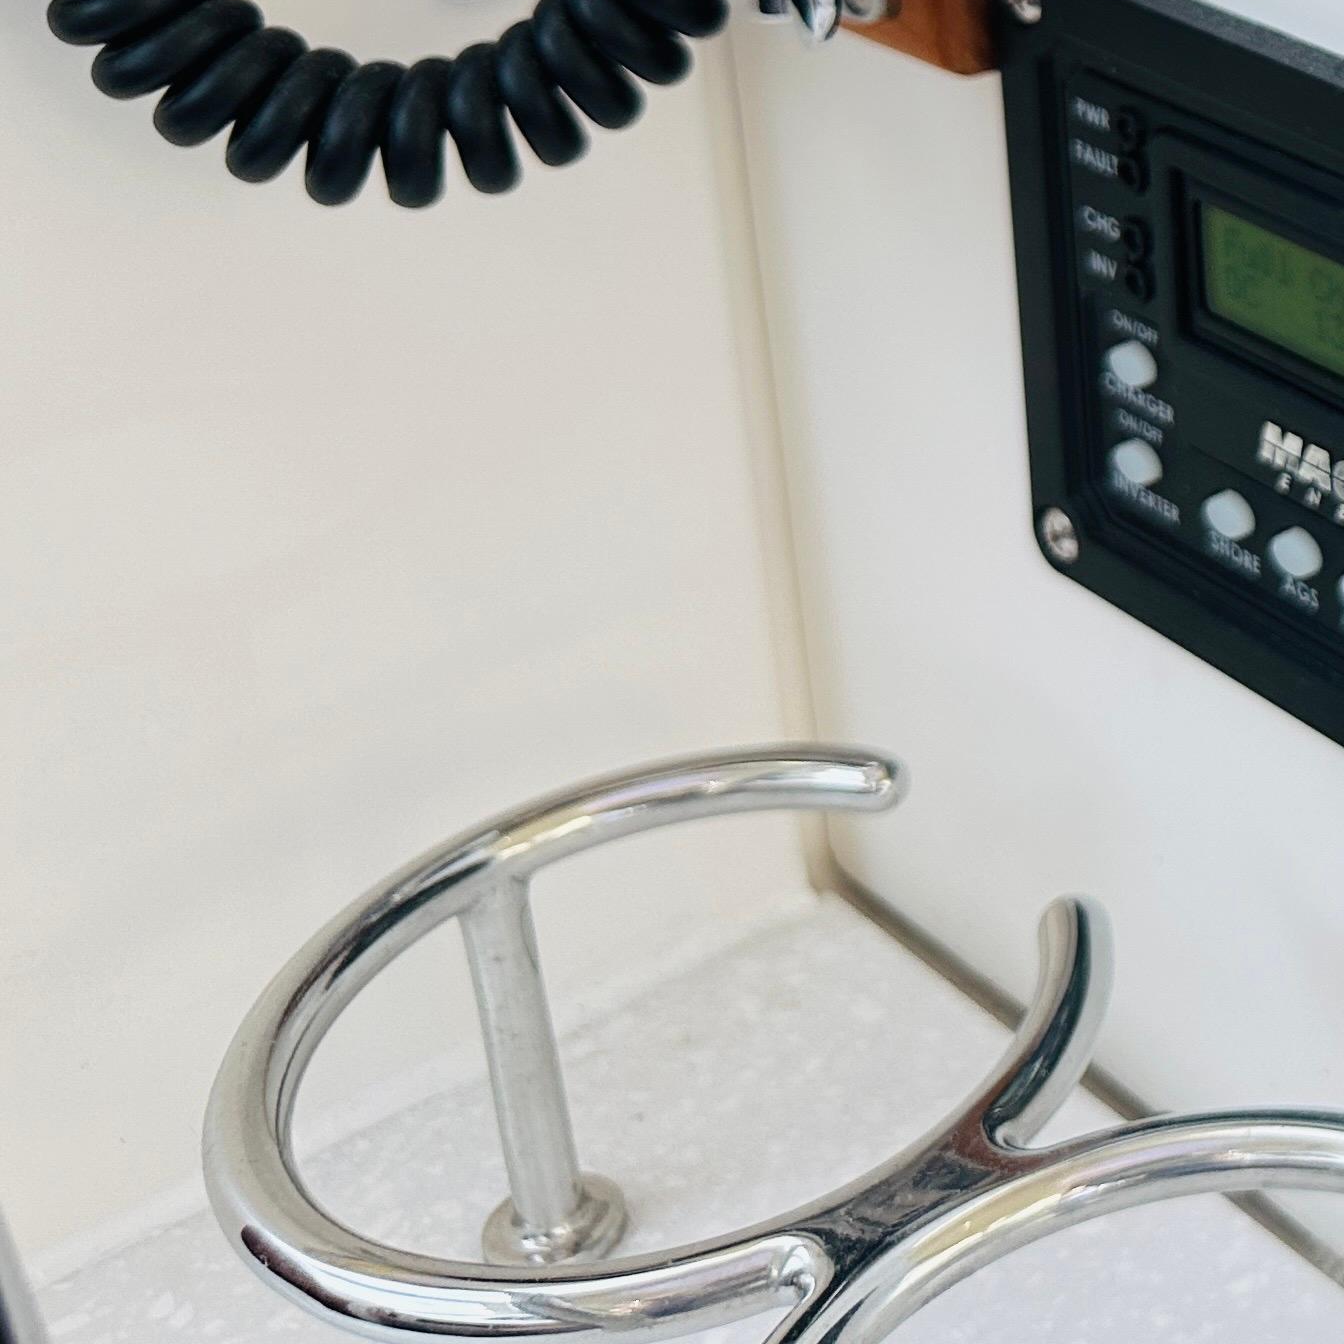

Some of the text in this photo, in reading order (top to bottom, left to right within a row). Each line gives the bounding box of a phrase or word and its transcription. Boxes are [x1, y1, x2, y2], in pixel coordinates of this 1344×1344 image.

[1073, 96, 1110, 131] PWR
[1078, 205, 1121, 241] CHG
[1089, 248, 1117, 280] INV
[1280, 574, 1320, 611] AGS
